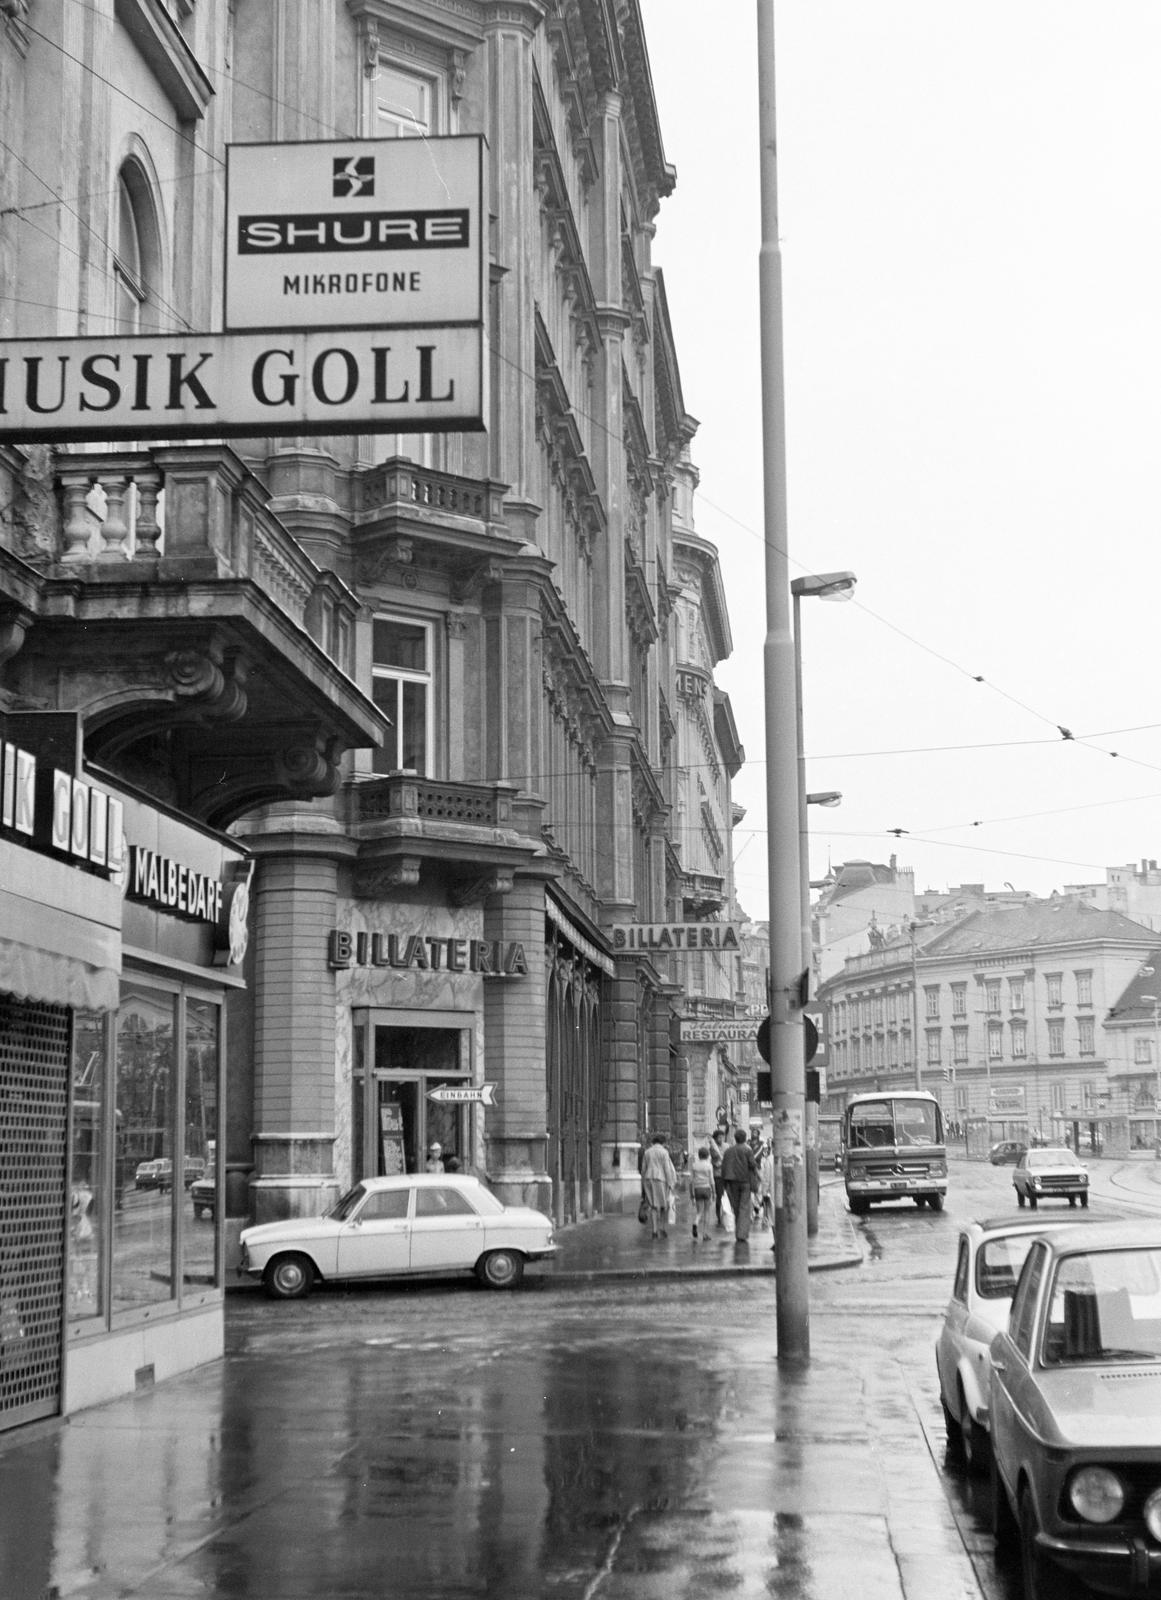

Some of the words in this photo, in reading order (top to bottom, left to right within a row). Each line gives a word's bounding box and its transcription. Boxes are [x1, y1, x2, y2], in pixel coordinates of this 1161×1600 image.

[245, 216, 464, 247] SHURE
[283, 271, 421, 295] MIKROFONE
[251, 345, 455, 408] GOLL
[52, 771, 122, 869] GOLL
[132, 845, 223, 923] MALBEDARF
[329, 930, 528, 975] BILLATERIA
[613, 926, 738, 948] BILLATERIA
